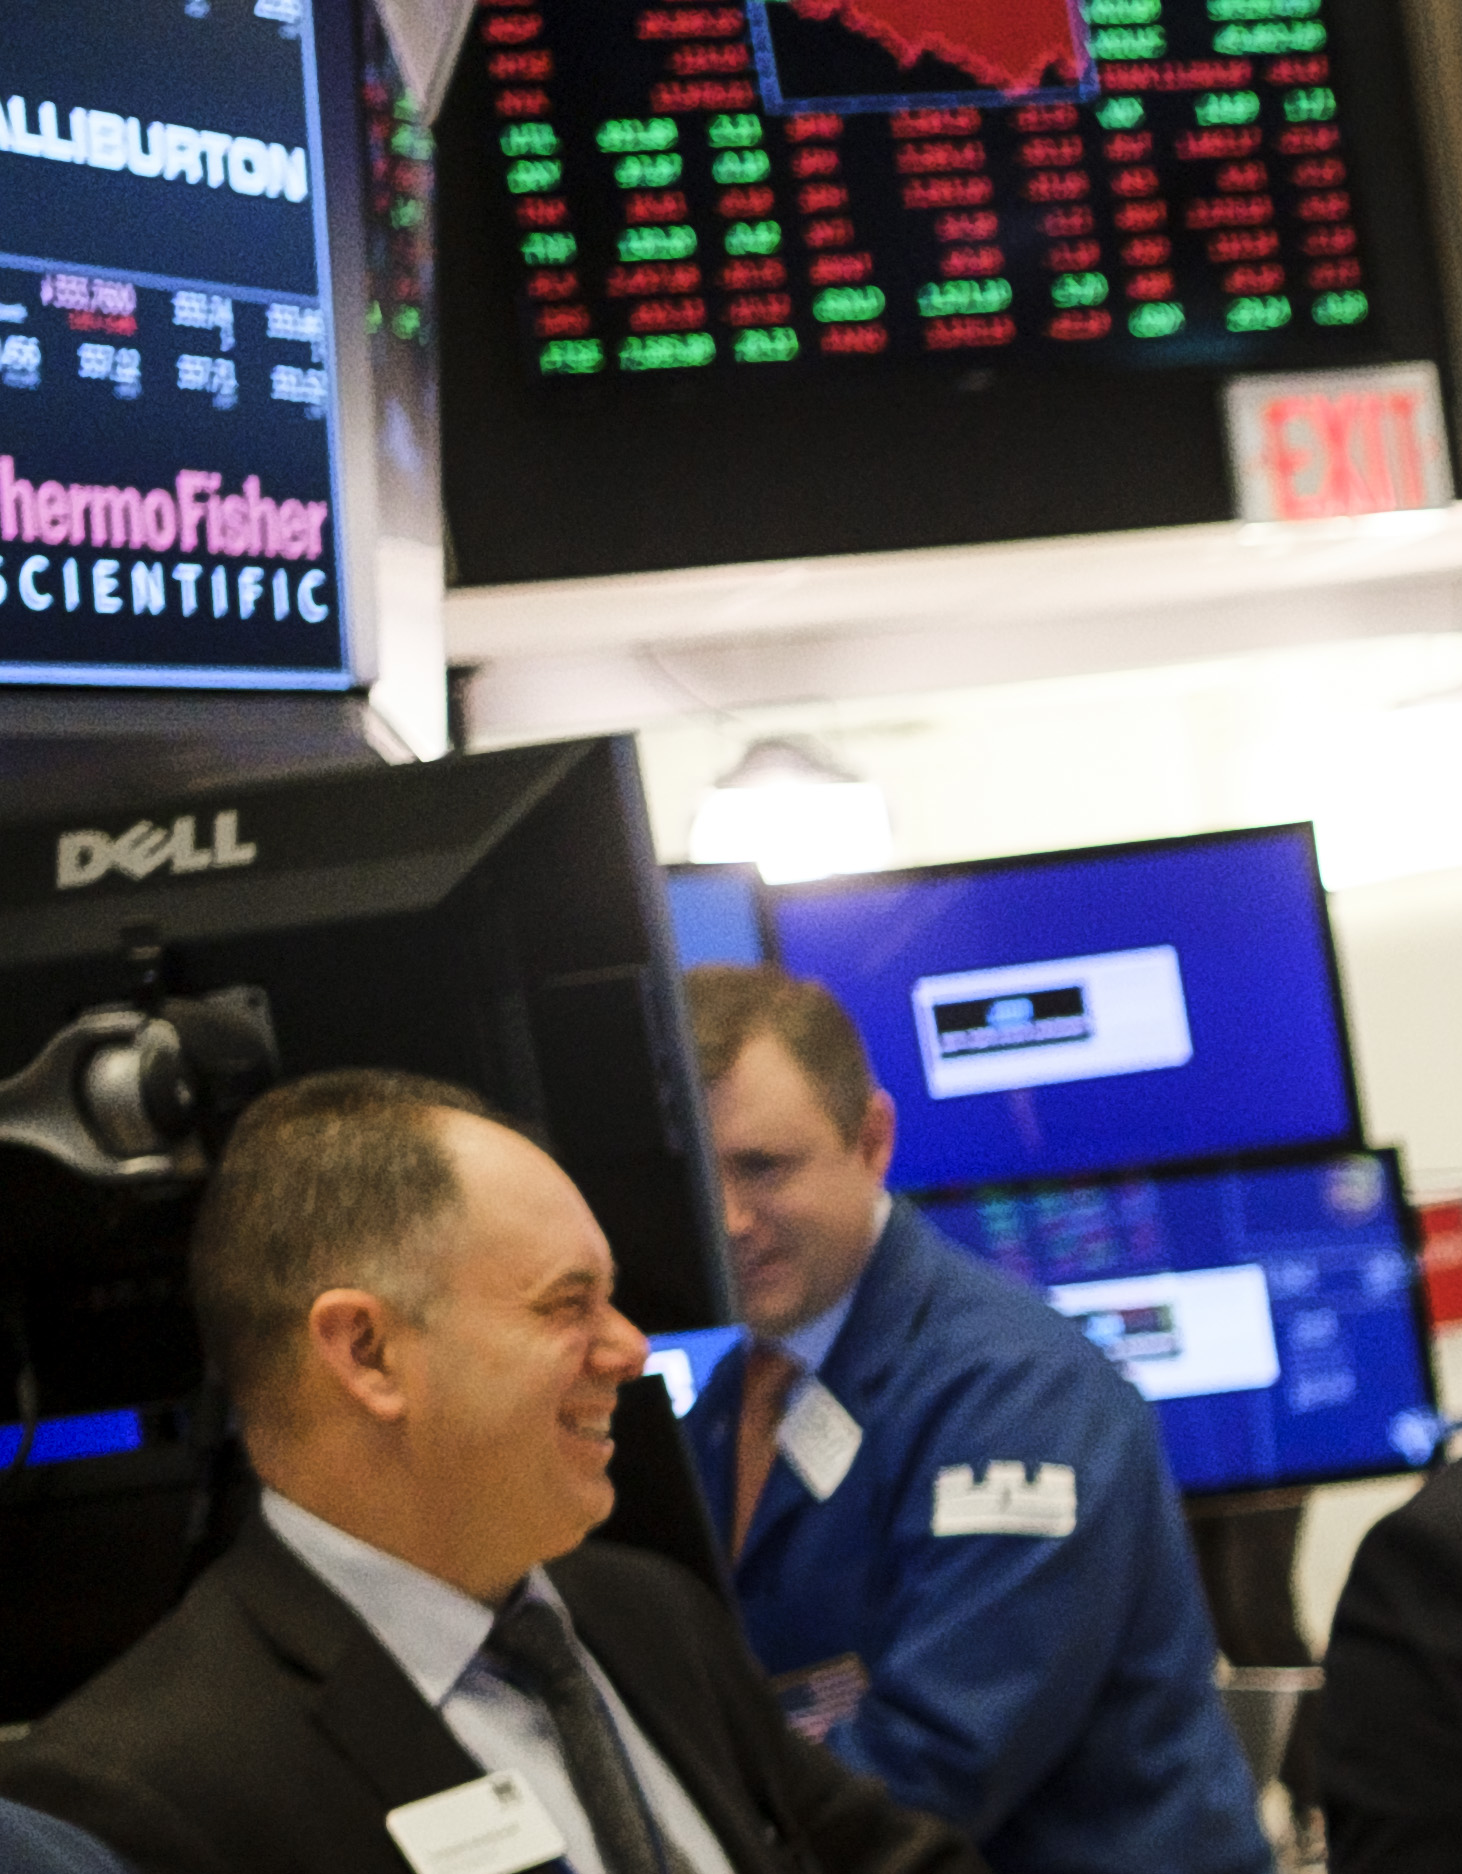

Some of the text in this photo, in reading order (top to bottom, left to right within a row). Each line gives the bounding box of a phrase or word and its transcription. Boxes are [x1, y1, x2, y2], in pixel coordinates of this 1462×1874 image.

[0, 95, 308, 203] LLIBURTON
[1261, 390, 1425, 520] EXIT
[0, 554, 329, 624] CIENTIFIC
[56, 810, 257, 891] DELL
